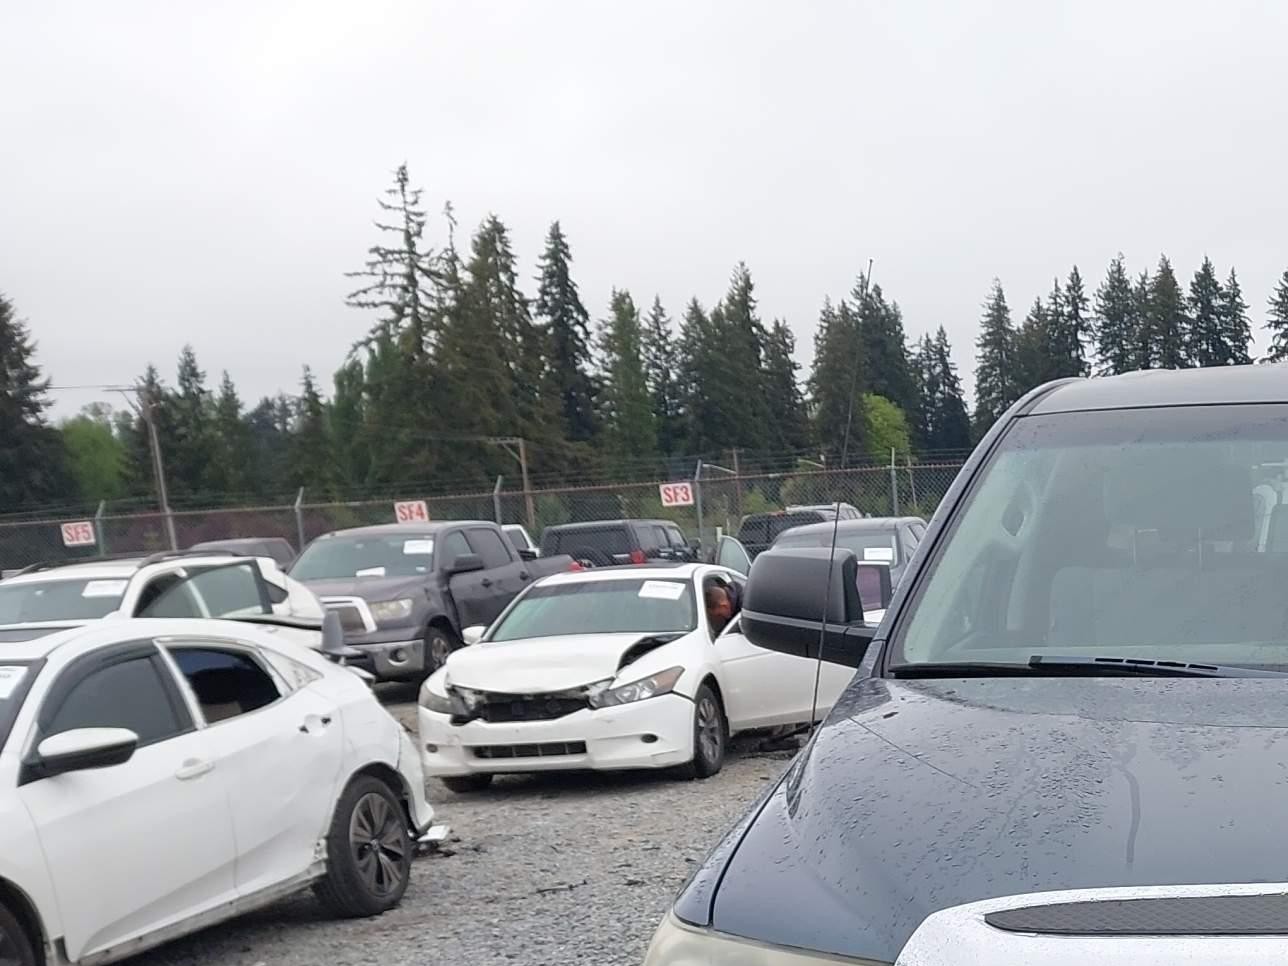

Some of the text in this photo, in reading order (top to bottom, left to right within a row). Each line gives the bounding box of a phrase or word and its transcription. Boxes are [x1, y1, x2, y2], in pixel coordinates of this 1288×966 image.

[662, 485, 690, 503] SF3
[398, 503, 425, 521] SF4
[64, 523, 91, 542] SF5
